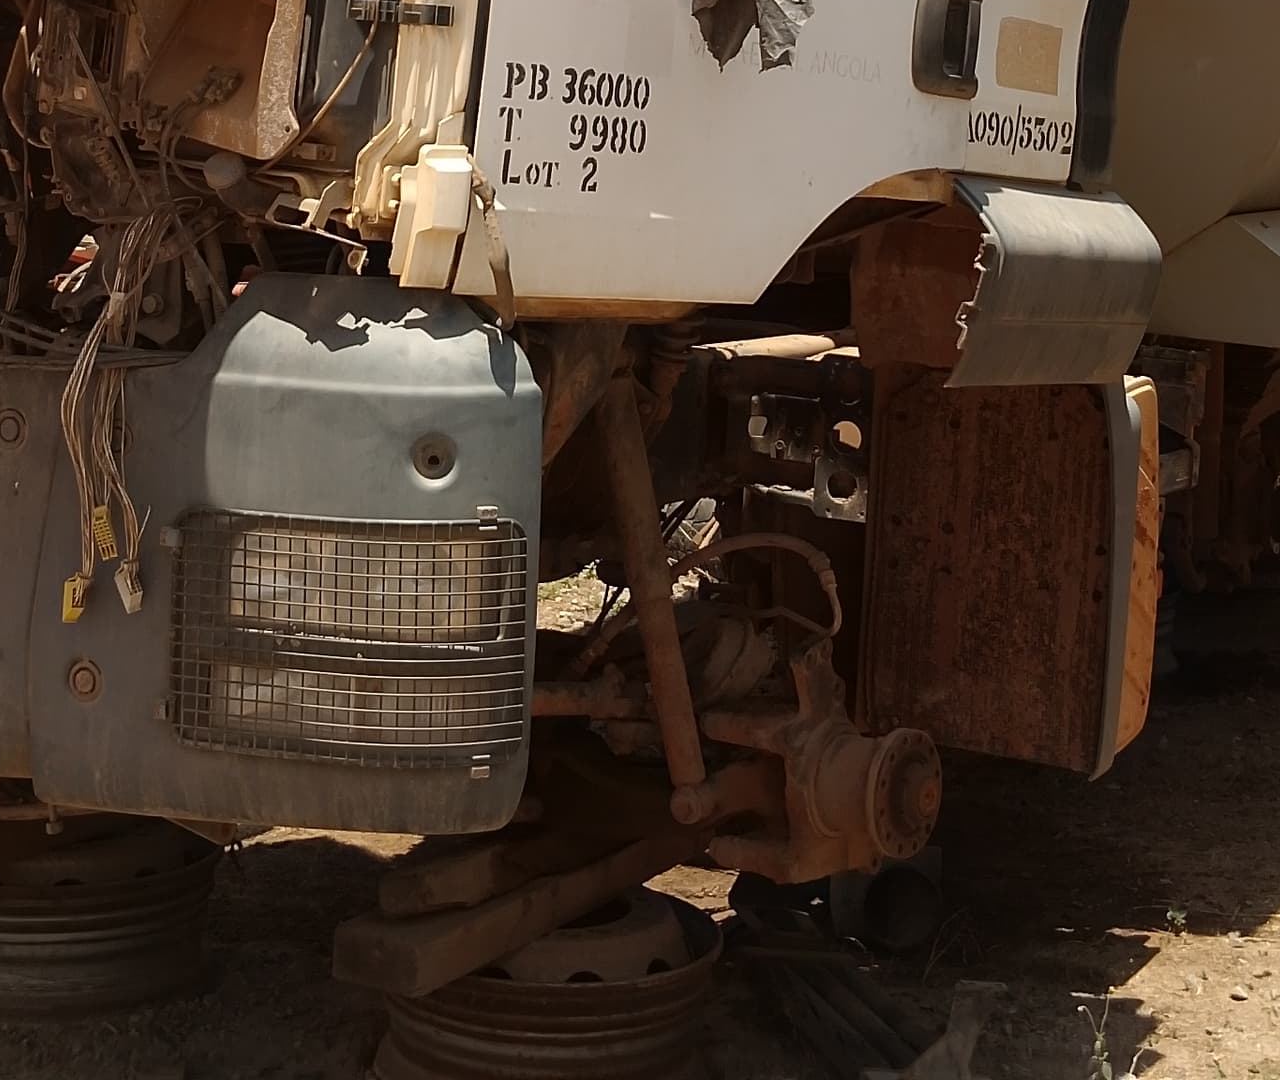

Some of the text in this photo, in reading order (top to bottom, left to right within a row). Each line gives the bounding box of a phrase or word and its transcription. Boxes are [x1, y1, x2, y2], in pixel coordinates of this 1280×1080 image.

[562, 67, 650, 110] 36000
[569, 114, 647, 154] 9980
[581, 156, 598, 192] 2
